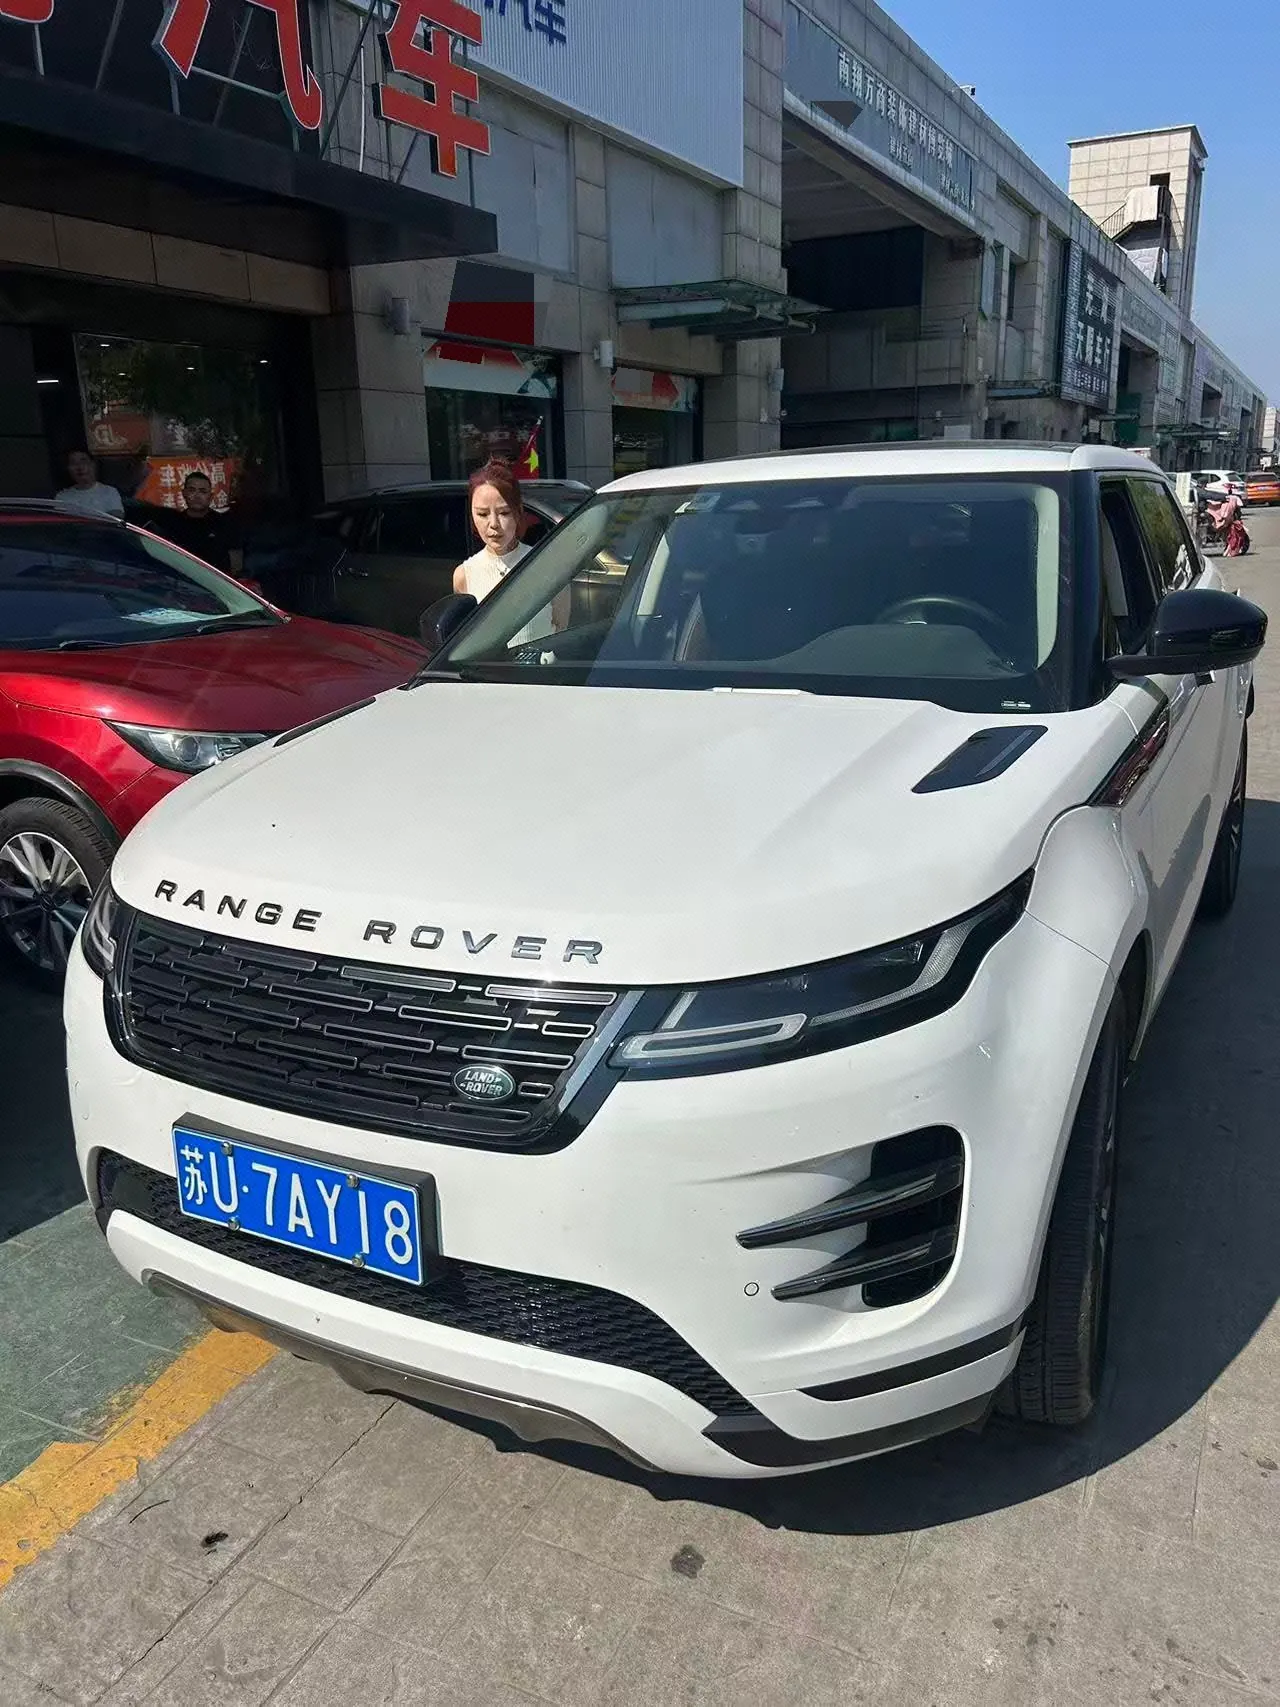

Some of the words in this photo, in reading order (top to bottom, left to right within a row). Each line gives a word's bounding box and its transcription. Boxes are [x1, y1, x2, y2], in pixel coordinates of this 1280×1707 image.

[155, 880, 322, 932] RANGE
[363, 919, 603, 965] ROVER
[465, 1082, 502, 1095] ROVER
